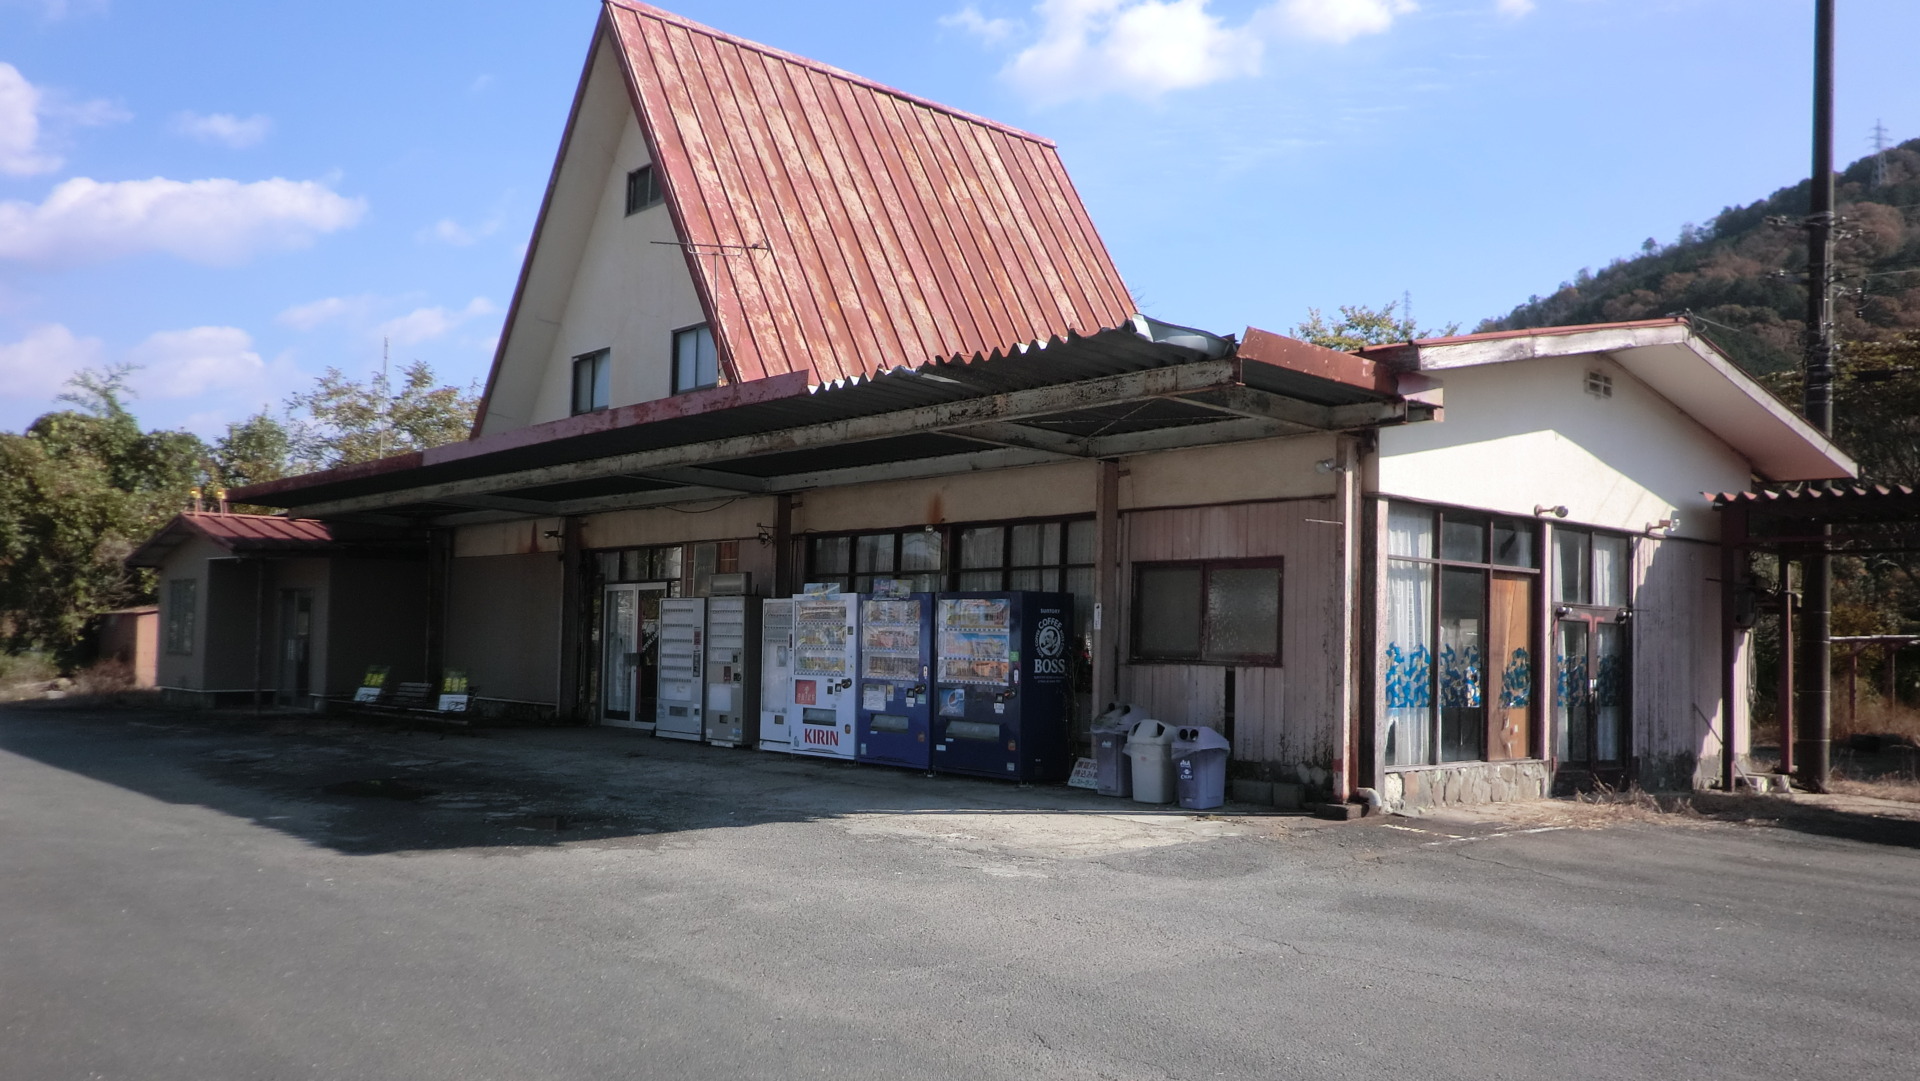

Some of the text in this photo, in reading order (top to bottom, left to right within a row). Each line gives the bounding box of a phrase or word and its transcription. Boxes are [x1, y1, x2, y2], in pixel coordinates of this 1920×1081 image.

[1038, 617, 1063, 630] COFFEE
[1034, 659, 1066, 673] BOSS
[804, 728, 839, 747] KIRIN
